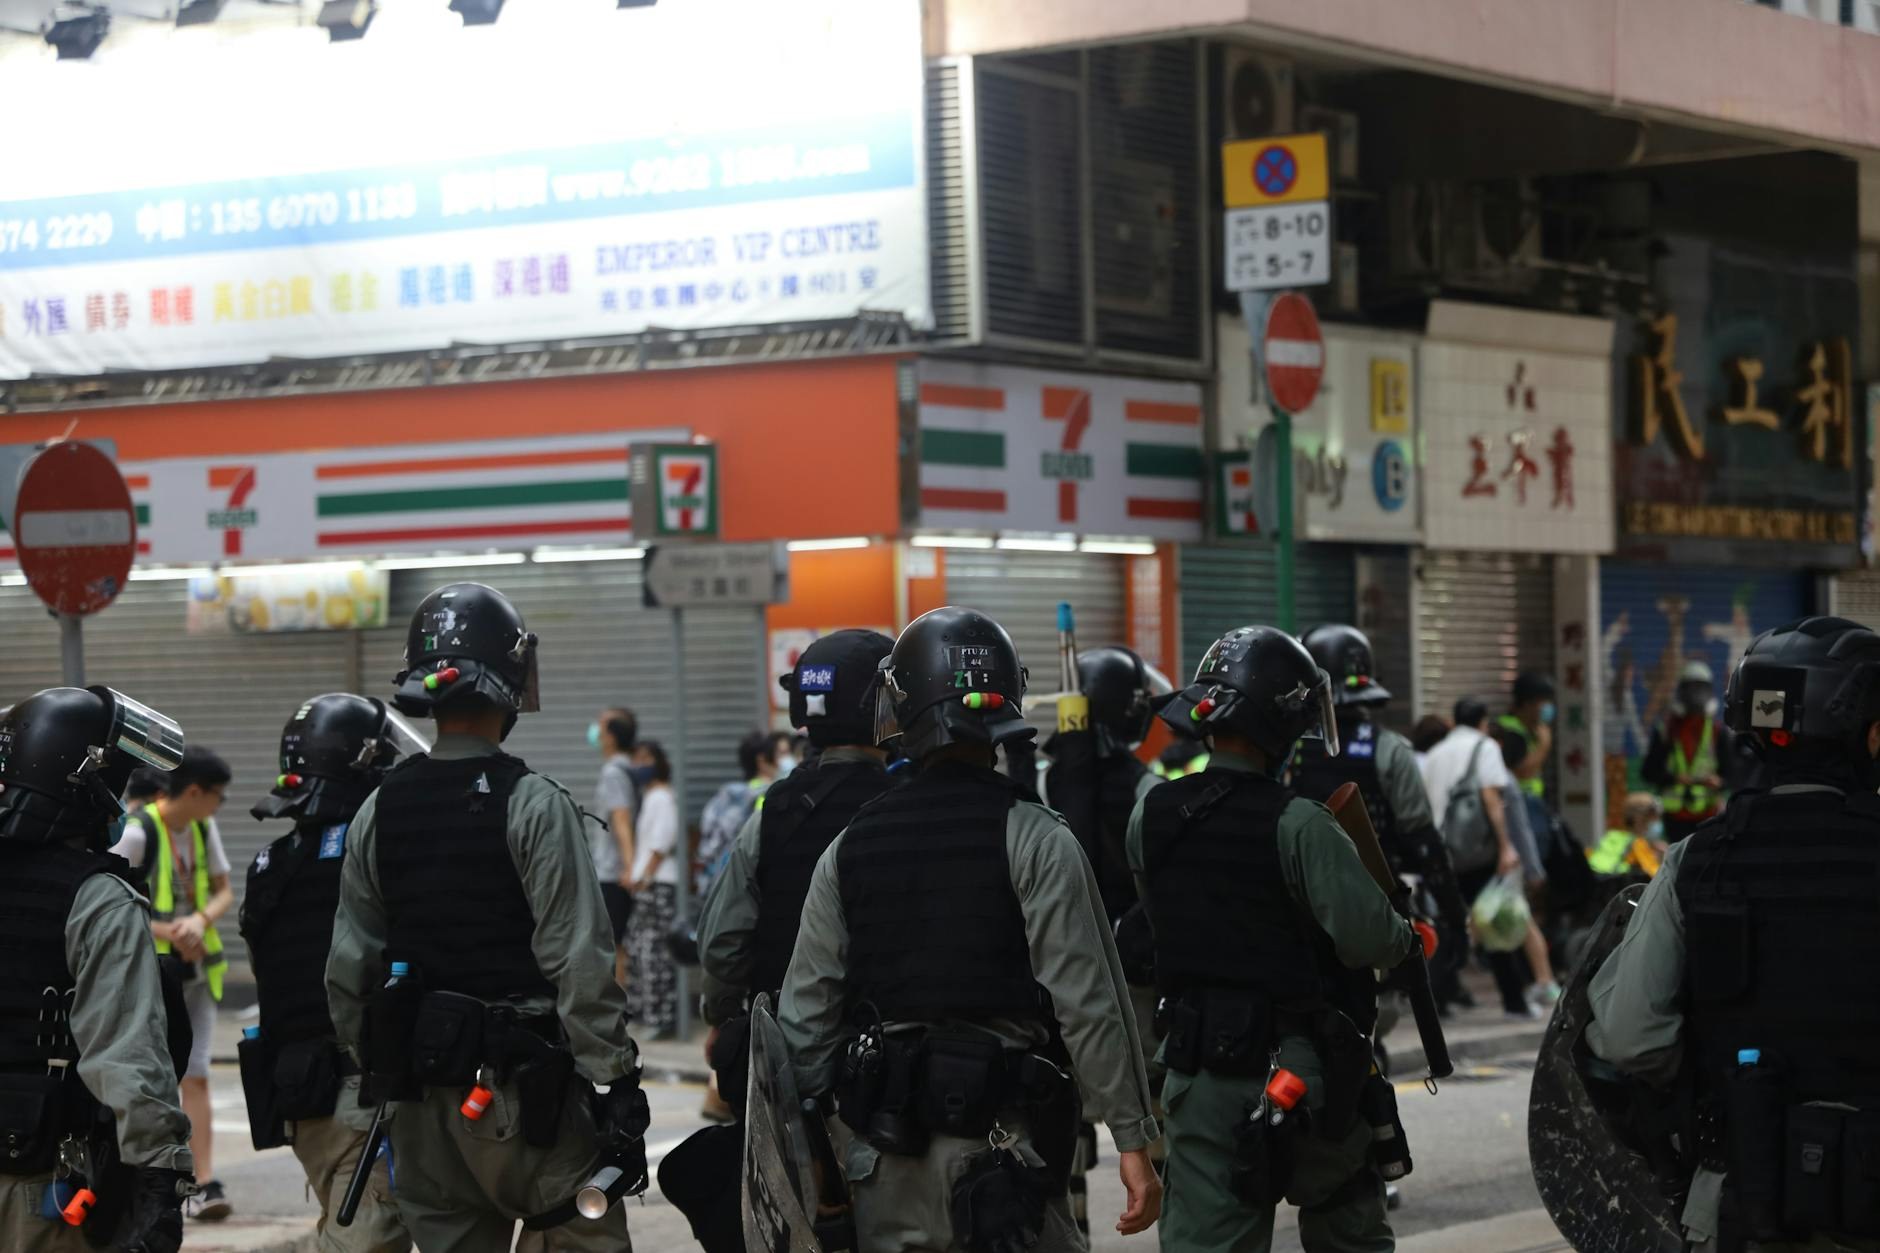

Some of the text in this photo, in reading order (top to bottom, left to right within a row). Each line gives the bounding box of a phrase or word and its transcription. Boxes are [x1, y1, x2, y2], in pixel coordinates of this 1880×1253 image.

[46, 211, 113, 248] 2229
[1264, 211, 1324, 241] 8-10
[596, 219, 882, 275] EMPEROR VIP CENTRE
[424, 634, 438, 651] Z1
[954, 670, 973, 688] Z1
